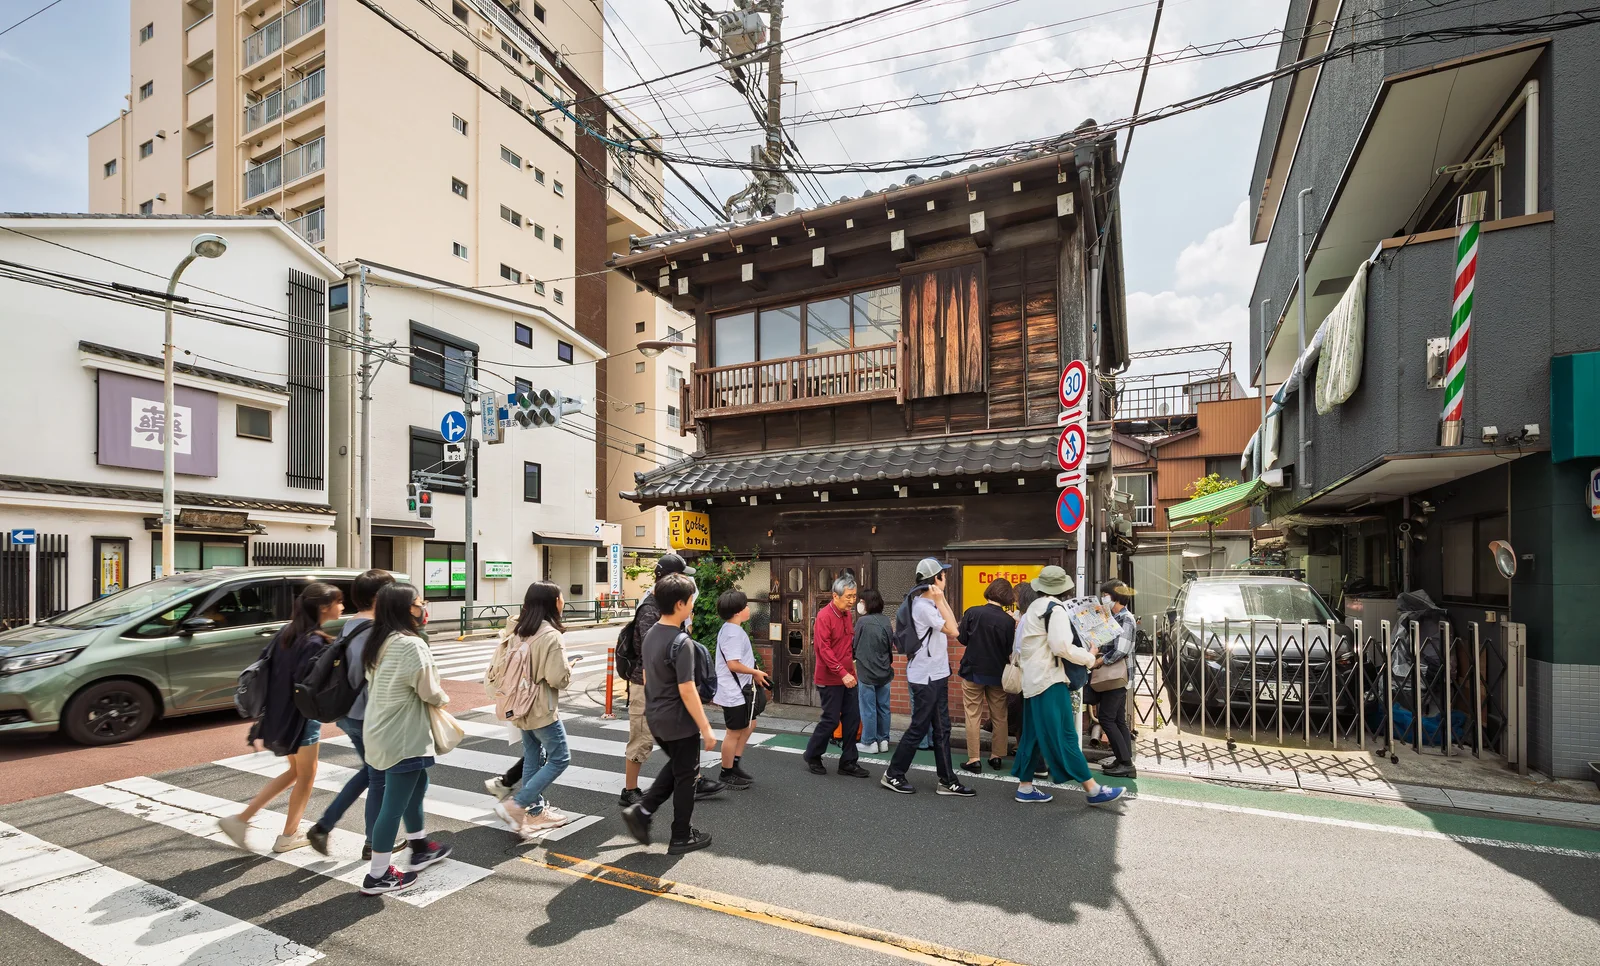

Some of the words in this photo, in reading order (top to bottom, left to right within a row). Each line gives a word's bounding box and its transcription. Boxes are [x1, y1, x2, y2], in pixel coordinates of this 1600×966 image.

[1065, 372, 1081, 396] 30
[486, 396, 496, 438] 上野桜木
[671, 515, 681, 542] コーヒー
[686, 536, 709, 547] カヤバ
[978, 571, 1027, 584] Coffee
